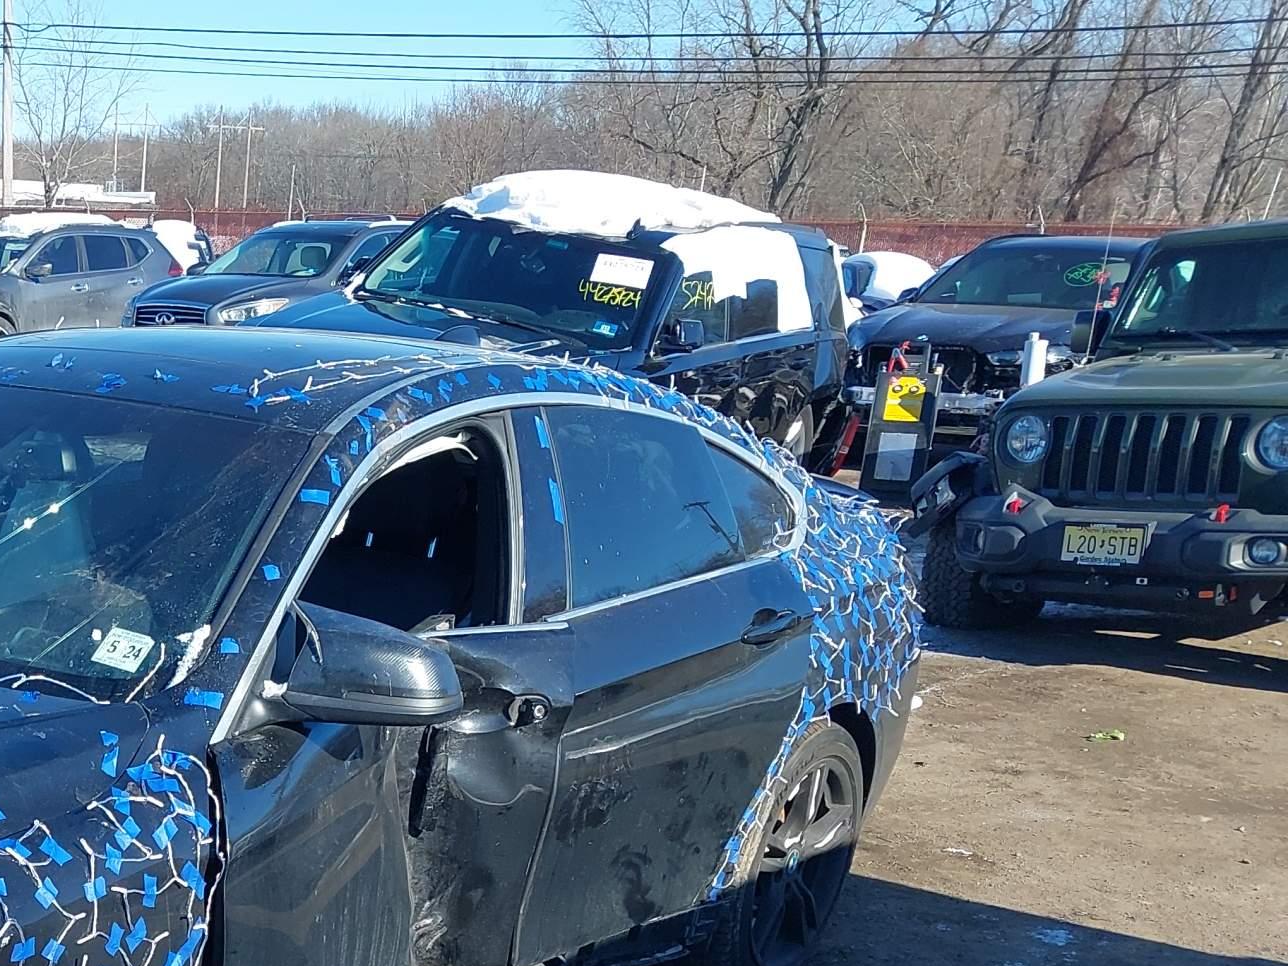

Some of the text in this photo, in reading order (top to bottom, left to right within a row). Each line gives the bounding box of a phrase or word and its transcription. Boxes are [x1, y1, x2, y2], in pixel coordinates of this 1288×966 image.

[1067, 534, 1139, 556] L20 STB
[107, 640, 142, 660] 5 24
